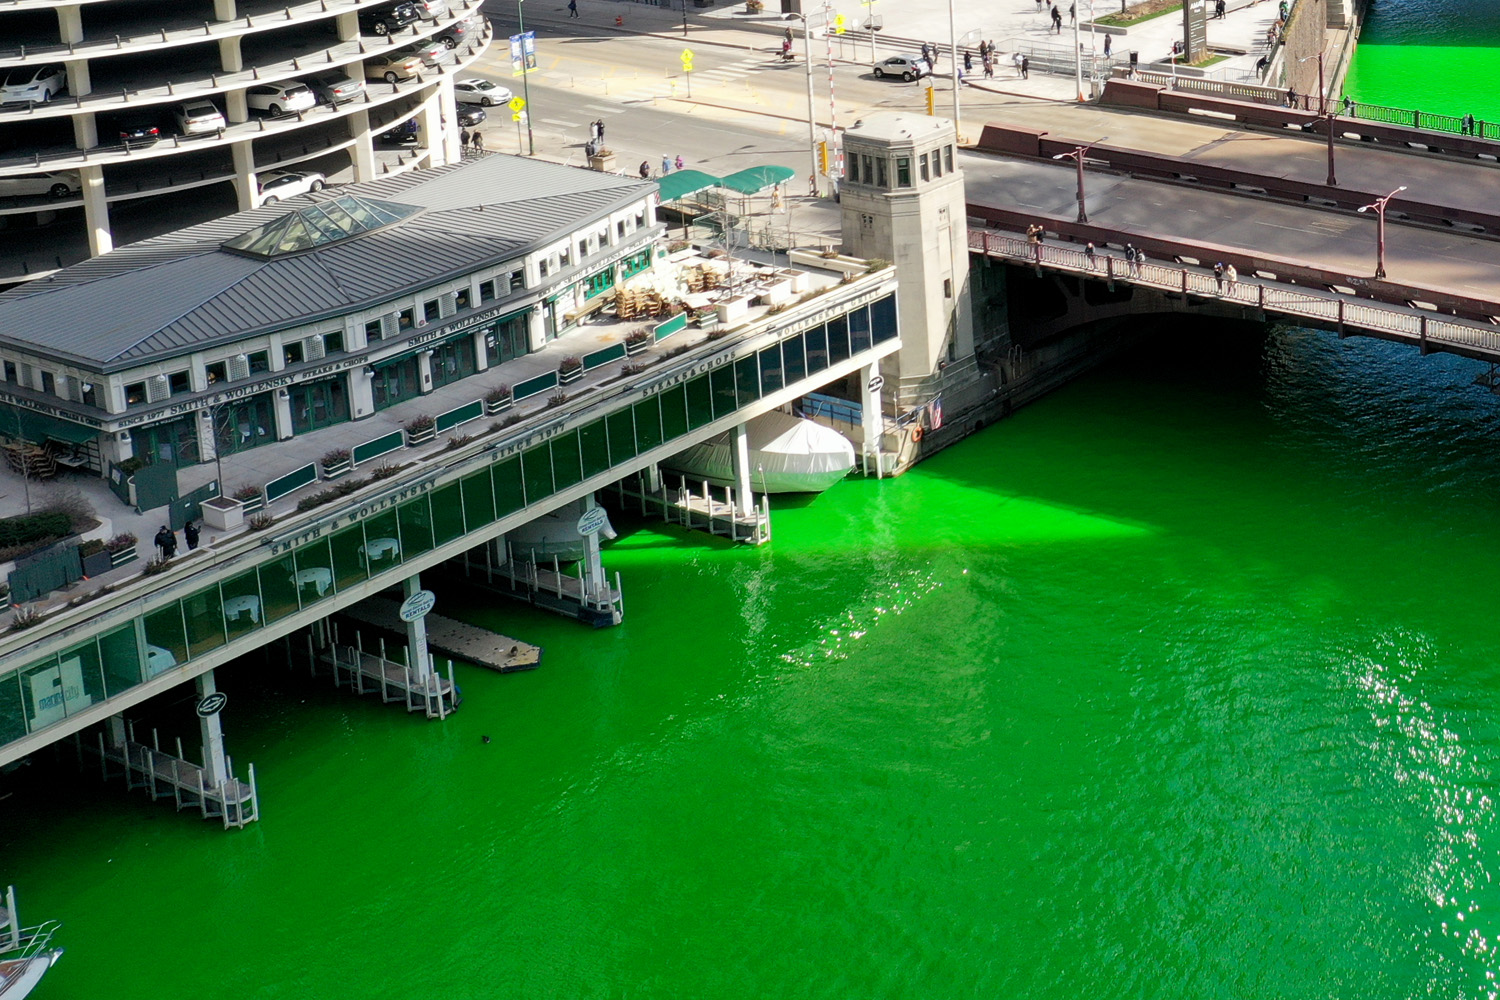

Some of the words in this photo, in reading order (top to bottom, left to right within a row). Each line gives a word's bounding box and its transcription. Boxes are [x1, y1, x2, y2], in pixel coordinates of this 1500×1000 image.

[408, 330, 437, 347] SMITH
[440, 327, 447, 335] &
[449, 307, 501, 332] WOLLENSKY
[118, 415, 145, 428] SINCE
[147, 410, 164, 420] 1977
[170, 397, 208, 415] SMITH
[213, 394, 221, 403] &
[225, 374, 296, 400] WOLLENSKY
[302, 364, 333, 379] STEAKS
[343, 356, 369, 368] CHOPS
[643, 373, 688, 397] STEAKS
[690, 368, 697, 377] &
[700, 351, 736, 372] CHOPS
[492, 438, 533, 461] SINCE
[540, 424, 565, 440] 1977
[271, 528, 321, 556] SMITH
[331, 520, 340, 530] &
[348, 479, 437, 522] WOLLENSKY
[405, 603, 431, 618] RENTALS
